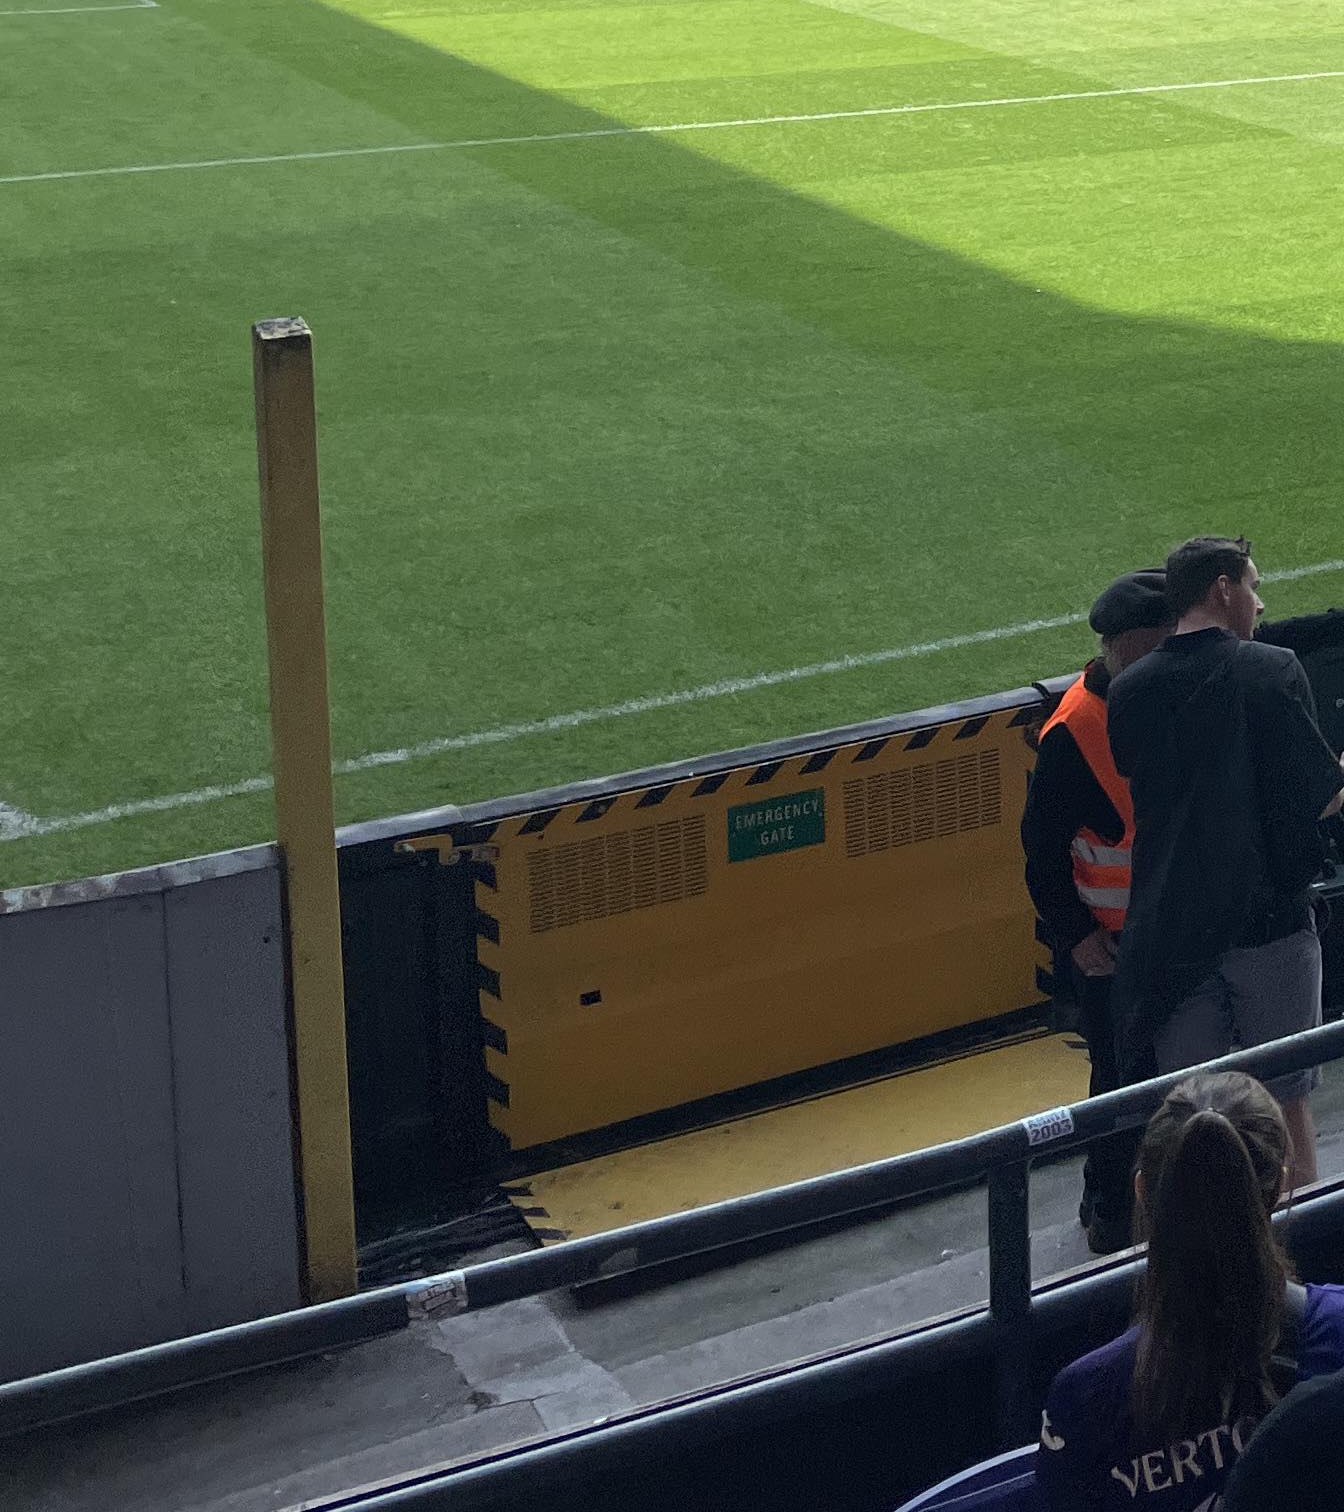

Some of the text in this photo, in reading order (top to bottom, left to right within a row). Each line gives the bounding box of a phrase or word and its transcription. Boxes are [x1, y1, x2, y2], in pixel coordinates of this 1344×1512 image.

[735, 799, 819, 830] EMERGENCY
[760, 825, 794, 845] GATE
[1031, 1118, 1072, 1144] 2003
